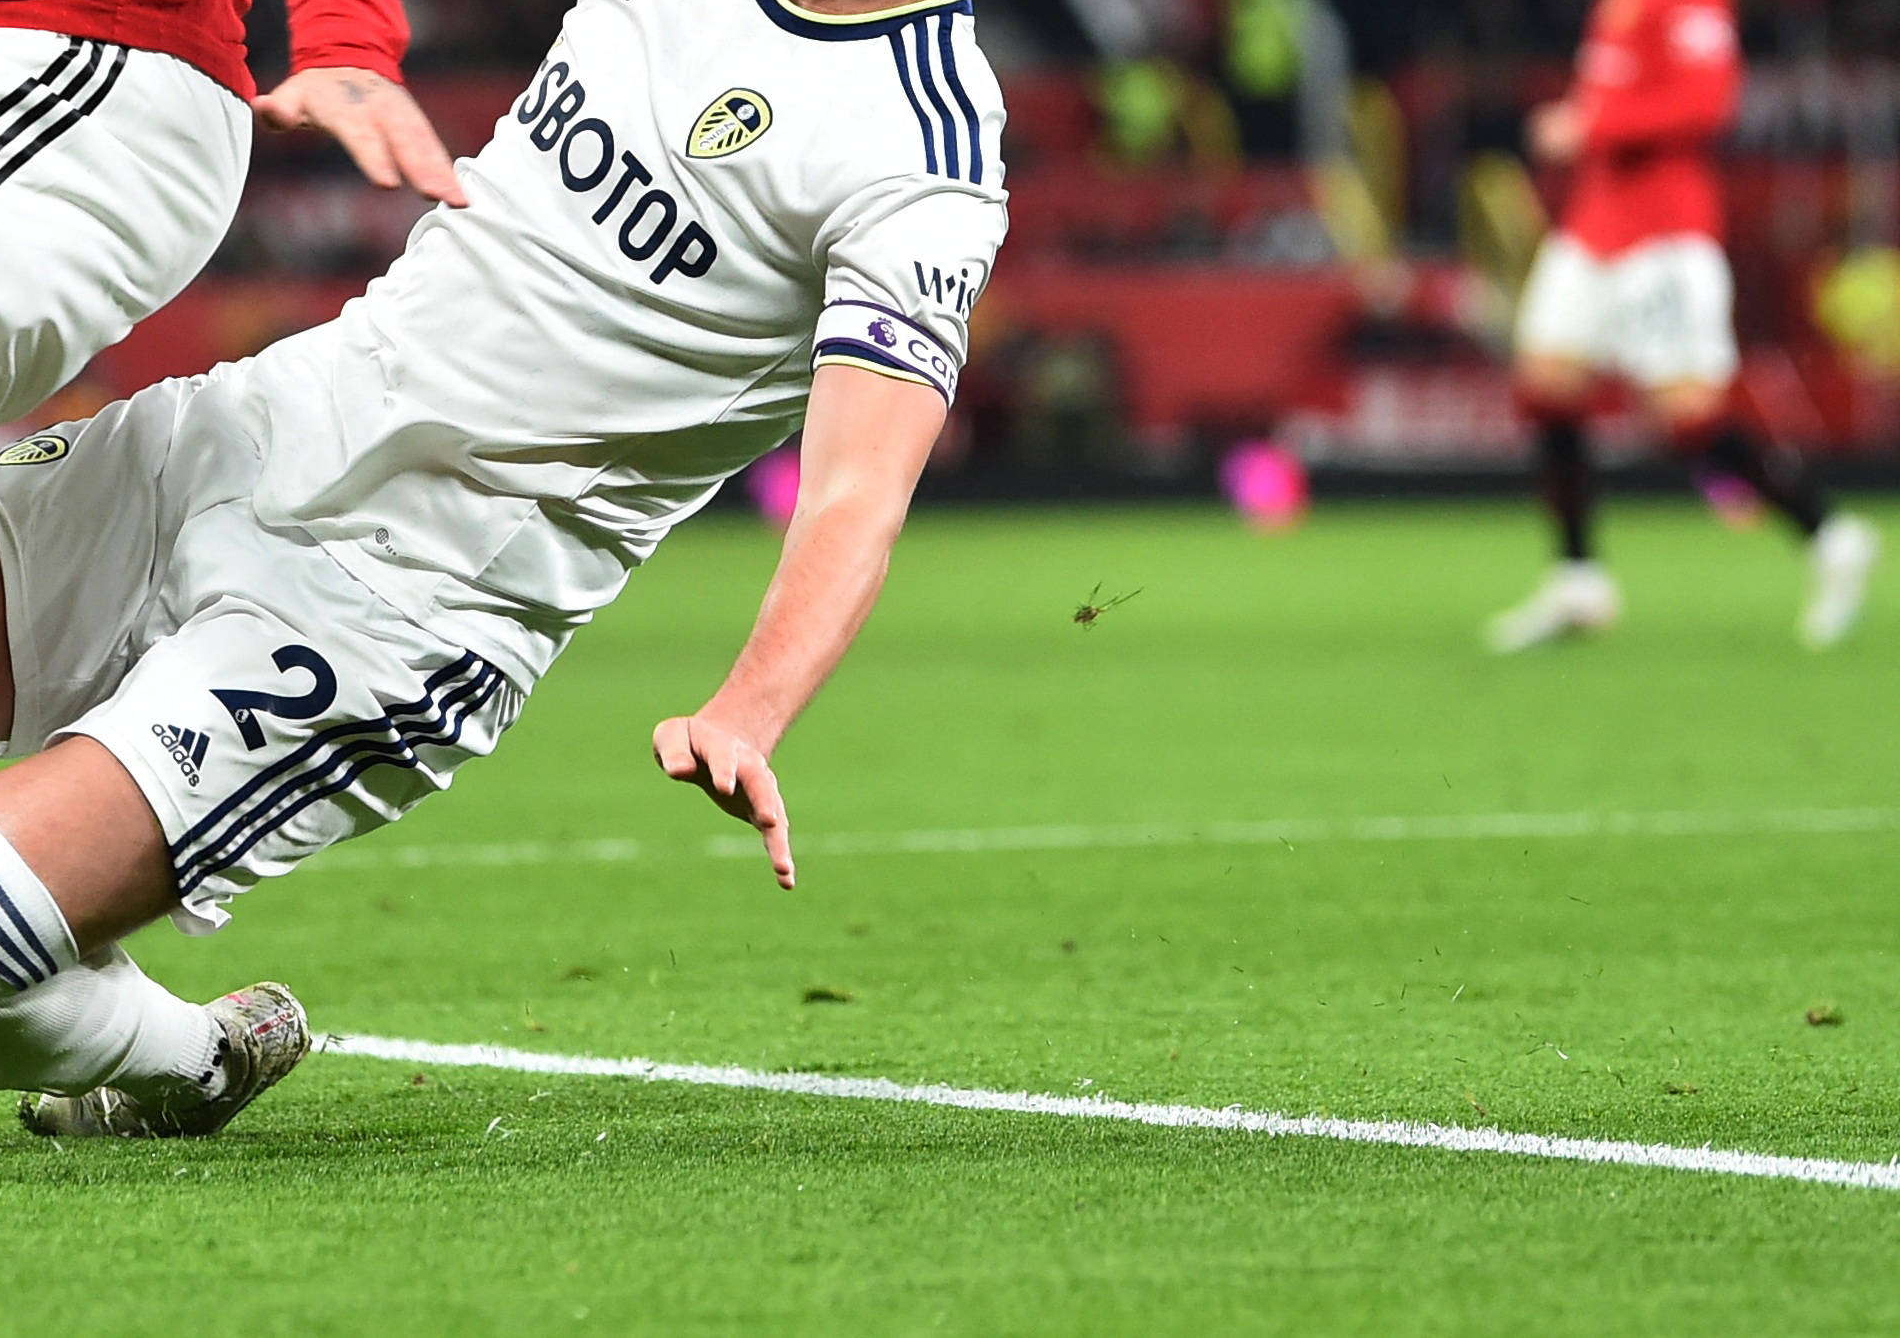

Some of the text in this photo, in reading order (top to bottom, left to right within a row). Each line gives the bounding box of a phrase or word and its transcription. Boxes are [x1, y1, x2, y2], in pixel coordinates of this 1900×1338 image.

[517, 61, 718, 285] SBOTOP
[208, 644, 338, 752] 2
[151, 723, 200, 788] adidas
